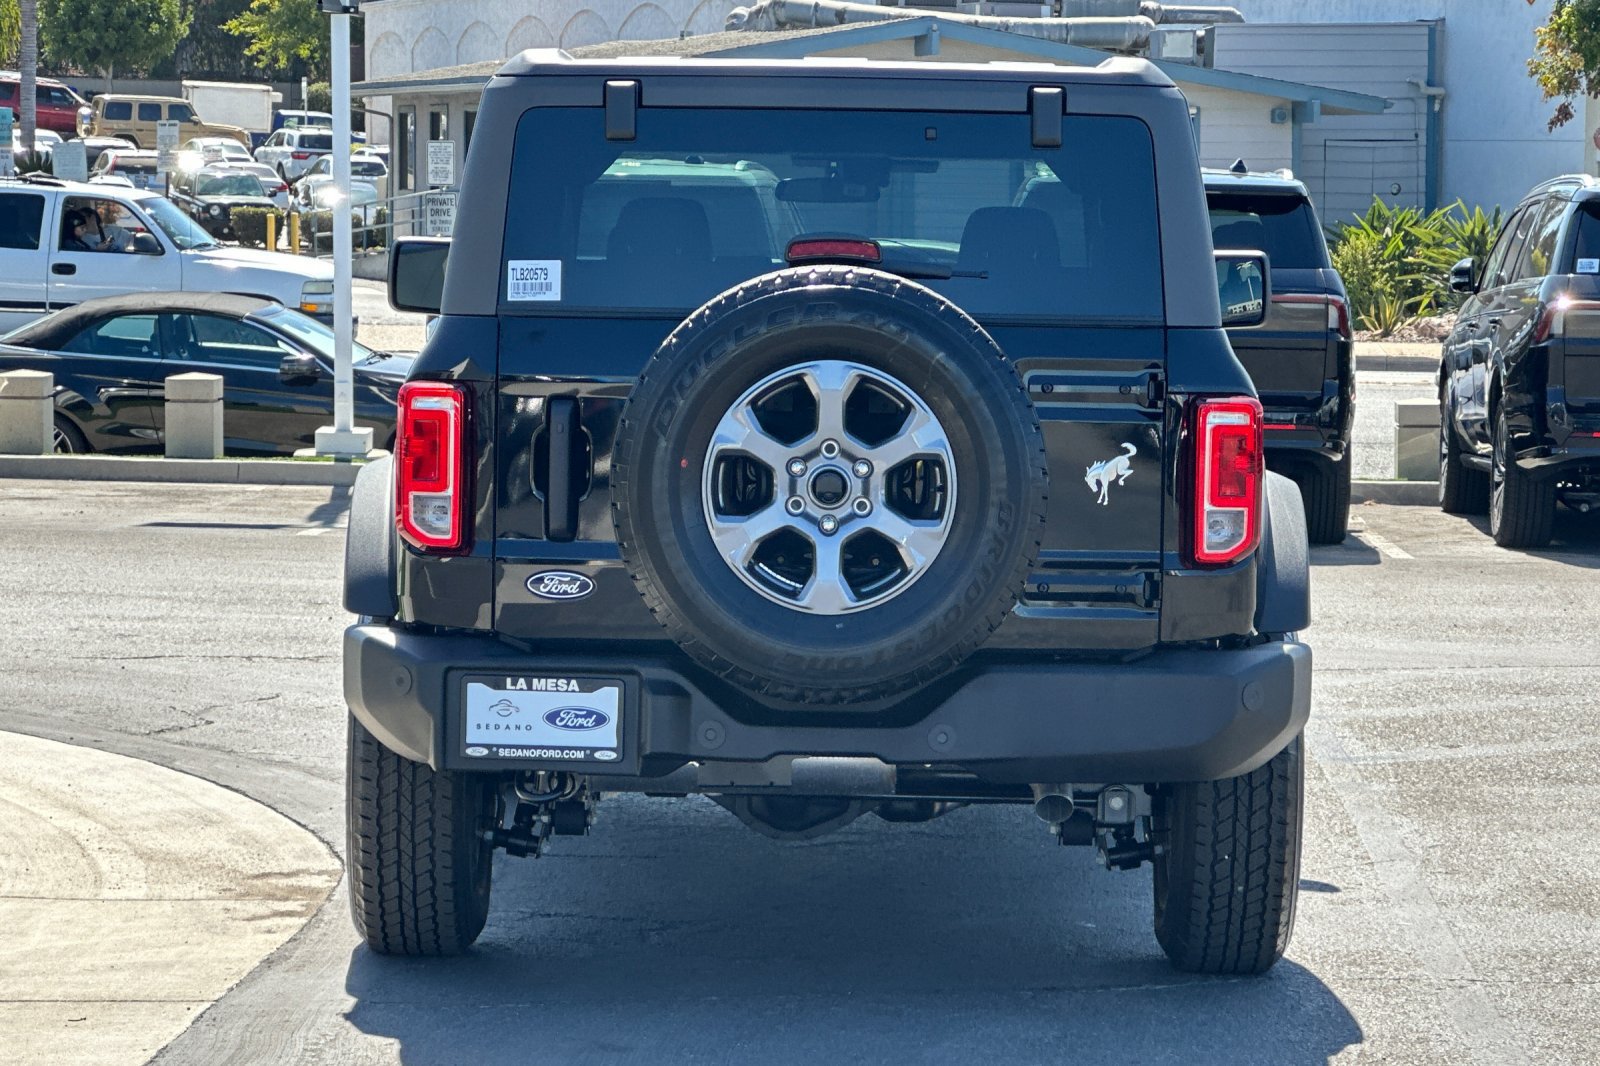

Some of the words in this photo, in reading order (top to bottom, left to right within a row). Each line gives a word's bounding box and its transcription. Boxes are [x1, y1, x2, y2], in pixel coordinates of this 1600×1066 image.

[427, 198, 454, 206] PRIVATE
[430, 208, 451, 217] DRIVE
[511, 267, 548, 281] TLB20579
[540, 575, 580, 594] Ford
[506, 677, 527, 690] LA
[532, 679, 580, 692] MESA
[555, 709, 597, 727] Ford
[476, 722, 533, 732] SEDANO
[498, 747, 585, 759] SEDANOFORD.COM
